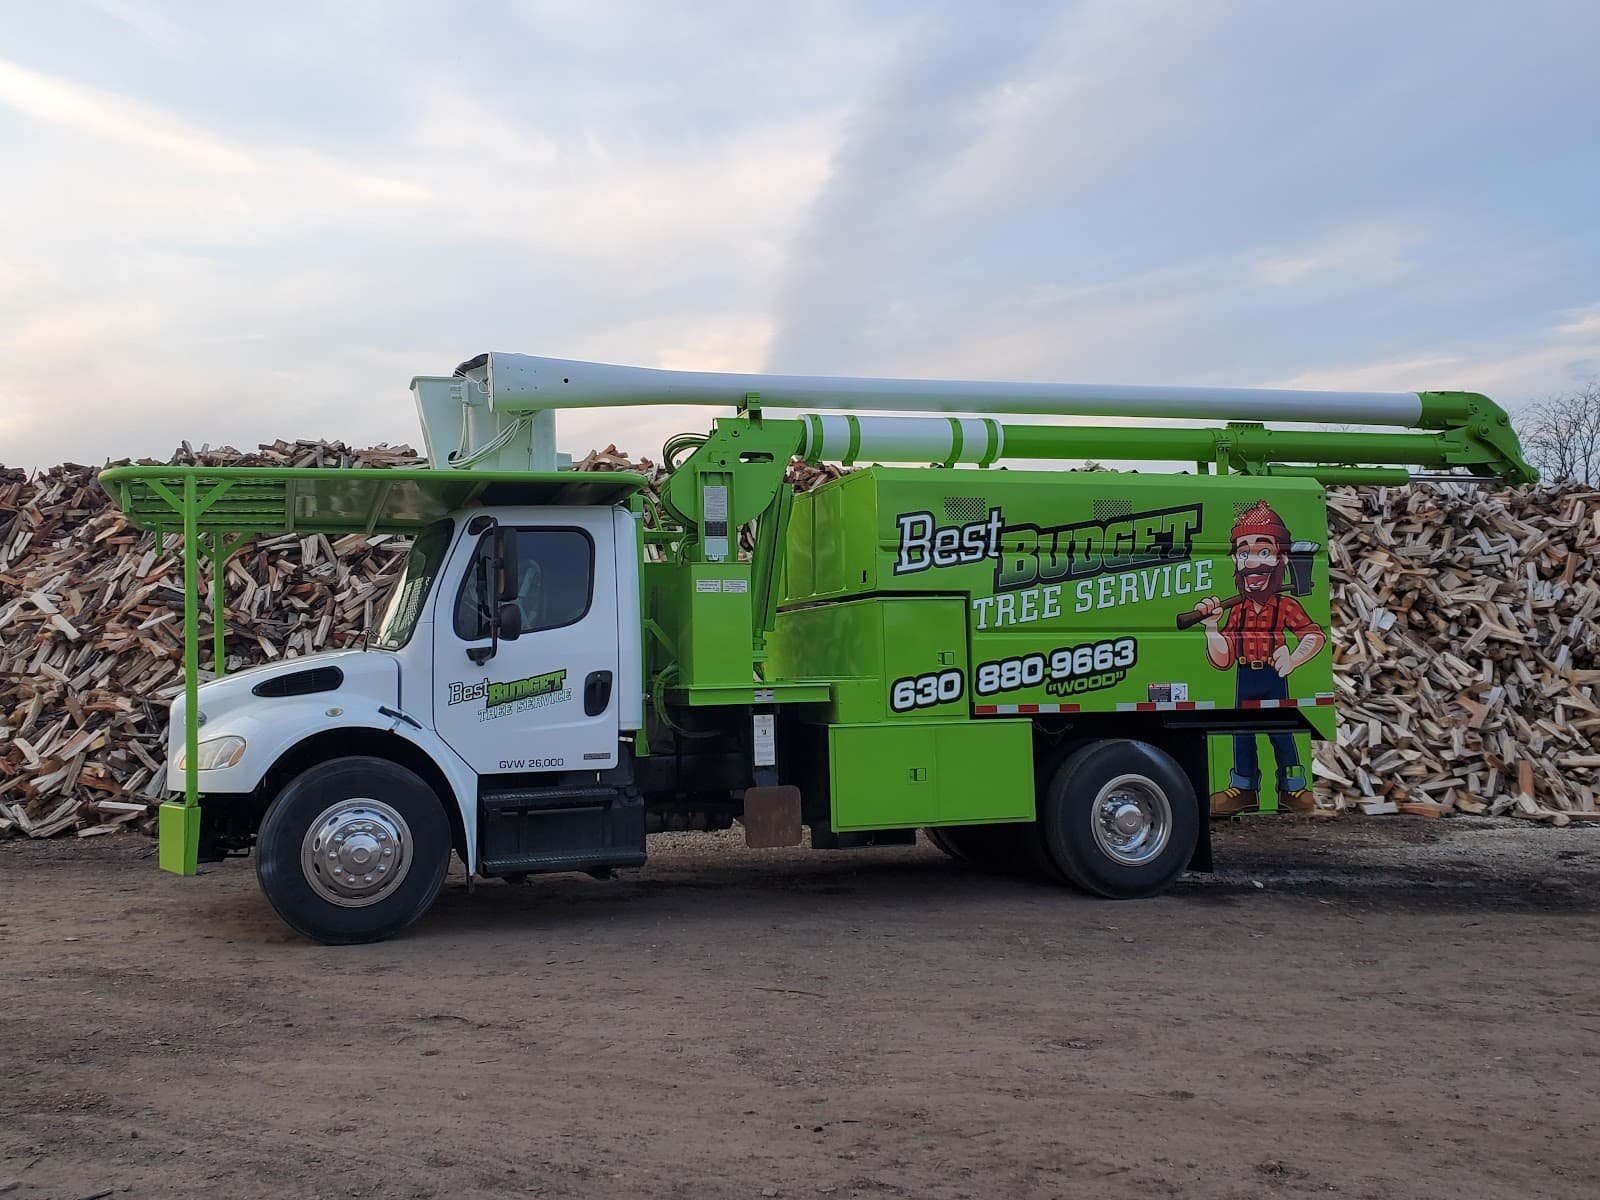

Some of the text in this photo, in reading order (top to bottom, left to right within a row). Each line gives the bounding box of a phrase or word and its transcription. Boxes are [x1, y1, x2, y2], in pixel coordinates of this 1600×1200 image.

[895, 508, 1200, 588] Best BUDGET
[972, 559, 1213, 630] TREE SERVICE
[448, 669, 566, 708] Best BUDGET
[478, 688, 572, 722] TREE SERVICE
[893, 671, 961, 709] 630
[499, 758, 564, 769] GVW 26,000
